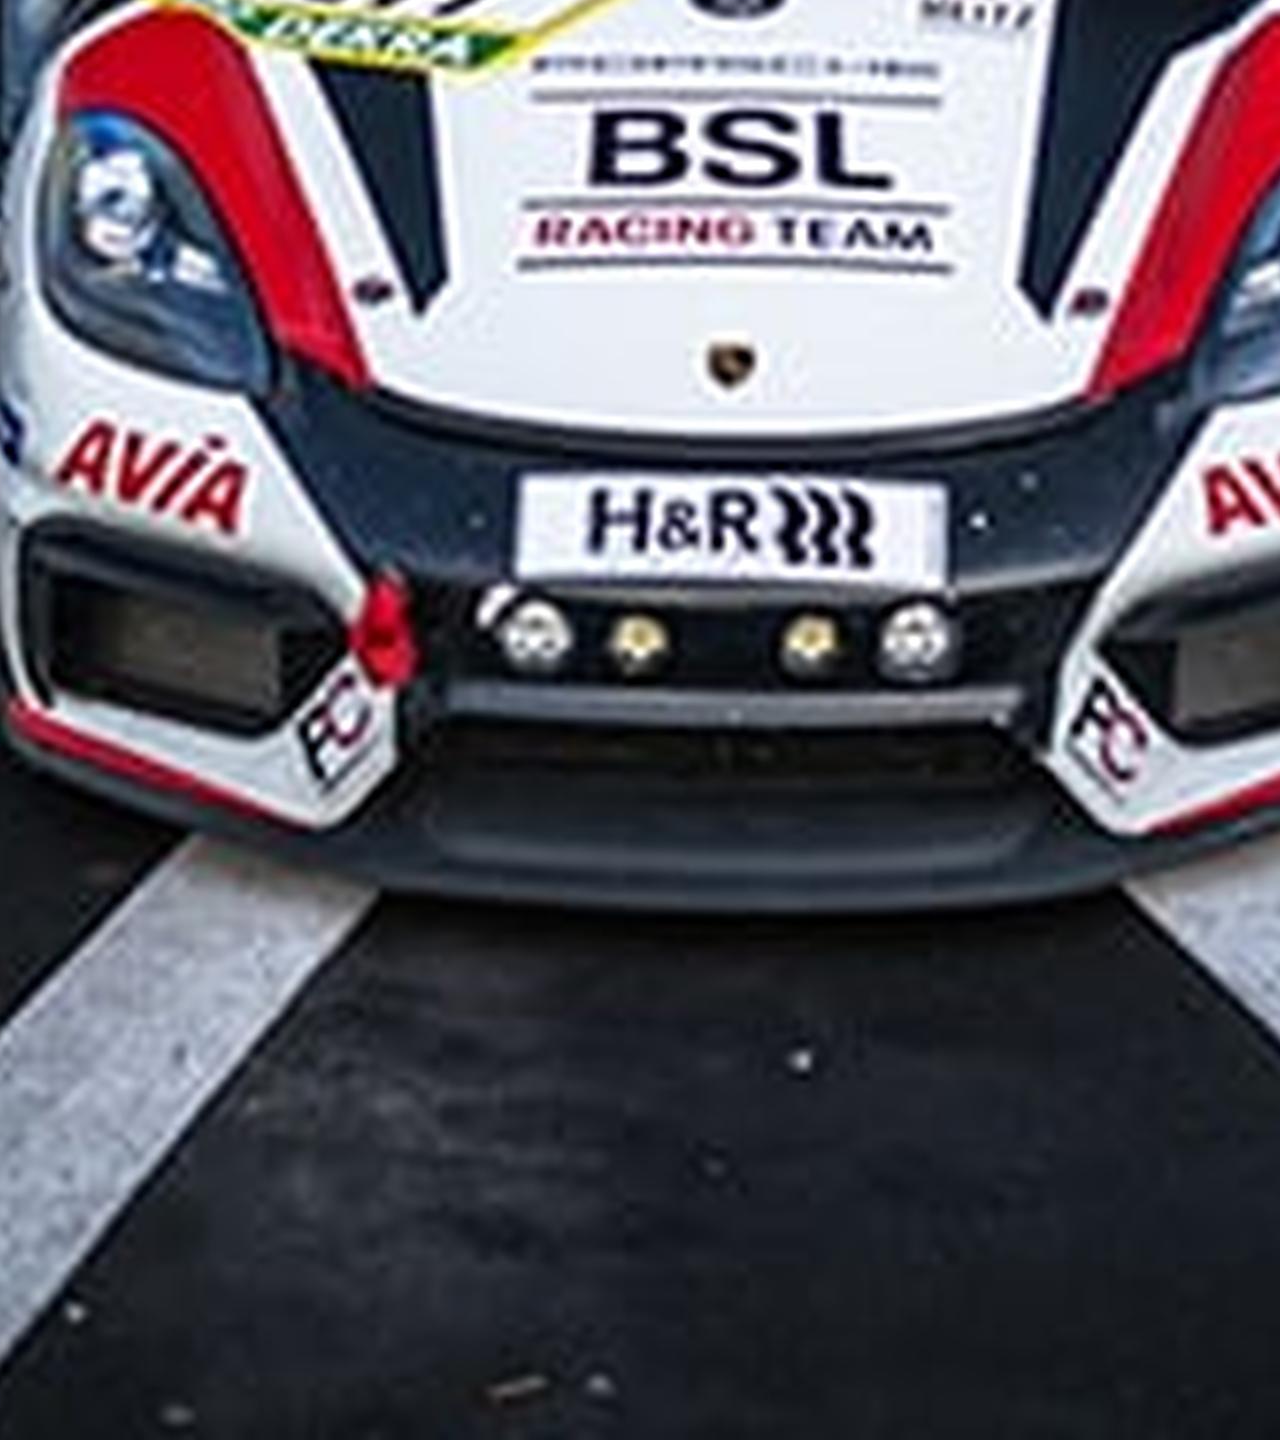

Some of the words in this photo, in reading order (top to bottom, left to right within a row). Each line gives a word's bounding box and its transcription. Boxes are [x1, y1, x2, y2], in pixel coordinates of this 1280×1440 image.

[586, 109, 895, 190] BSL
[533, 216, 758, 249] RACING
[774, 217, 935, 253] TEAM
[587, 486, 761, 555] H&R
